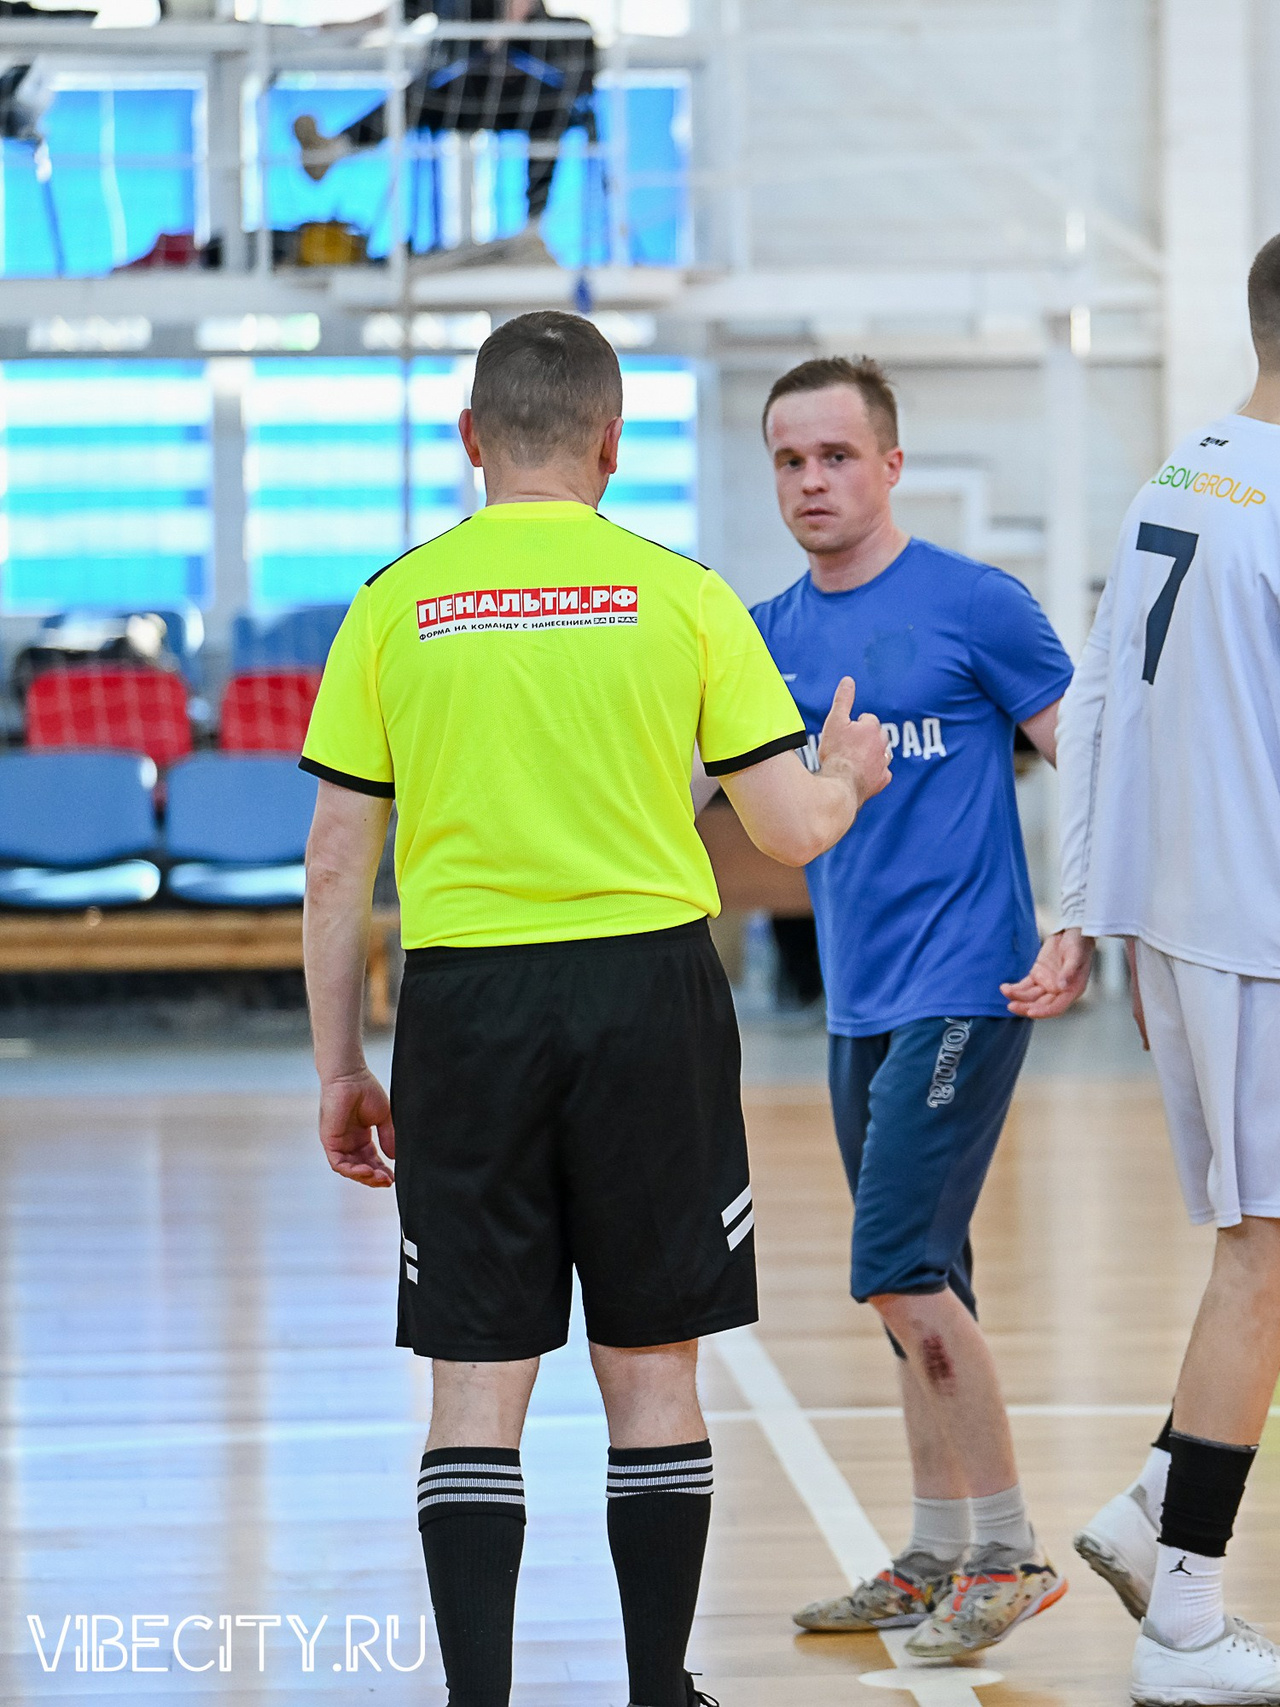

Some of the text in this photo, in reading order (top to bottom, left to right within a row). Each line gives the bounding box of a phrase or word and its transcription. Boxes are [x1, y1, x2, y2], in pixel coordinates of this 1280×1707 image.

[419, 588, 638, 624] ПЕНАЛЬТИ.РФ
[1136, 522, 1199, 685] 7
[419, 627, 451, 641] ФОРМА
[454, 624, 467, 632] НА
[471, 622, 519, 630] КОМАНДУ
[531, 619, 592, 629] НАНЕСЕНИЕМ
